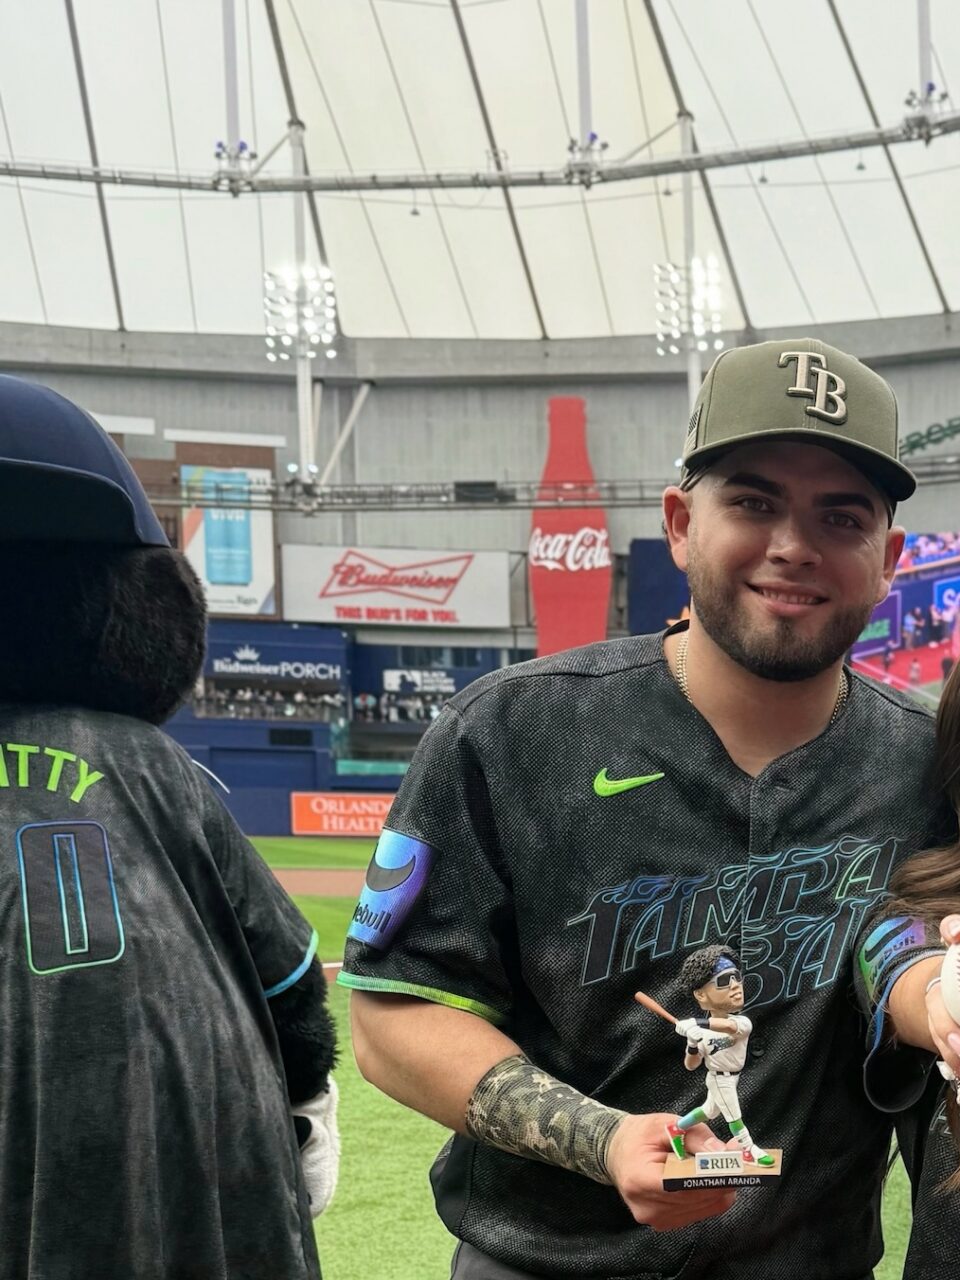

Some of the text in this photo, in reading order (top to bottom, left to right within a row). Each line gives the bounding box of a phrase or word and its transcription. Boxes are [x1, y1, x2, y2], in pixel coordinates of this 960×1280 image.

[778, 351, 847, 425] TB
[333, 563, 459, 590] Budweiser
[405, 608, 429, 622] FOR
[280, 661, 341, 679] PORCH
[16, 820, 125, 975] 0
[567, 834, 905, 988] TAMPA
[711, 1157, 740, 1169] RIPA
[683, 1177, 761, 1188] JONATHAN ARANDA
